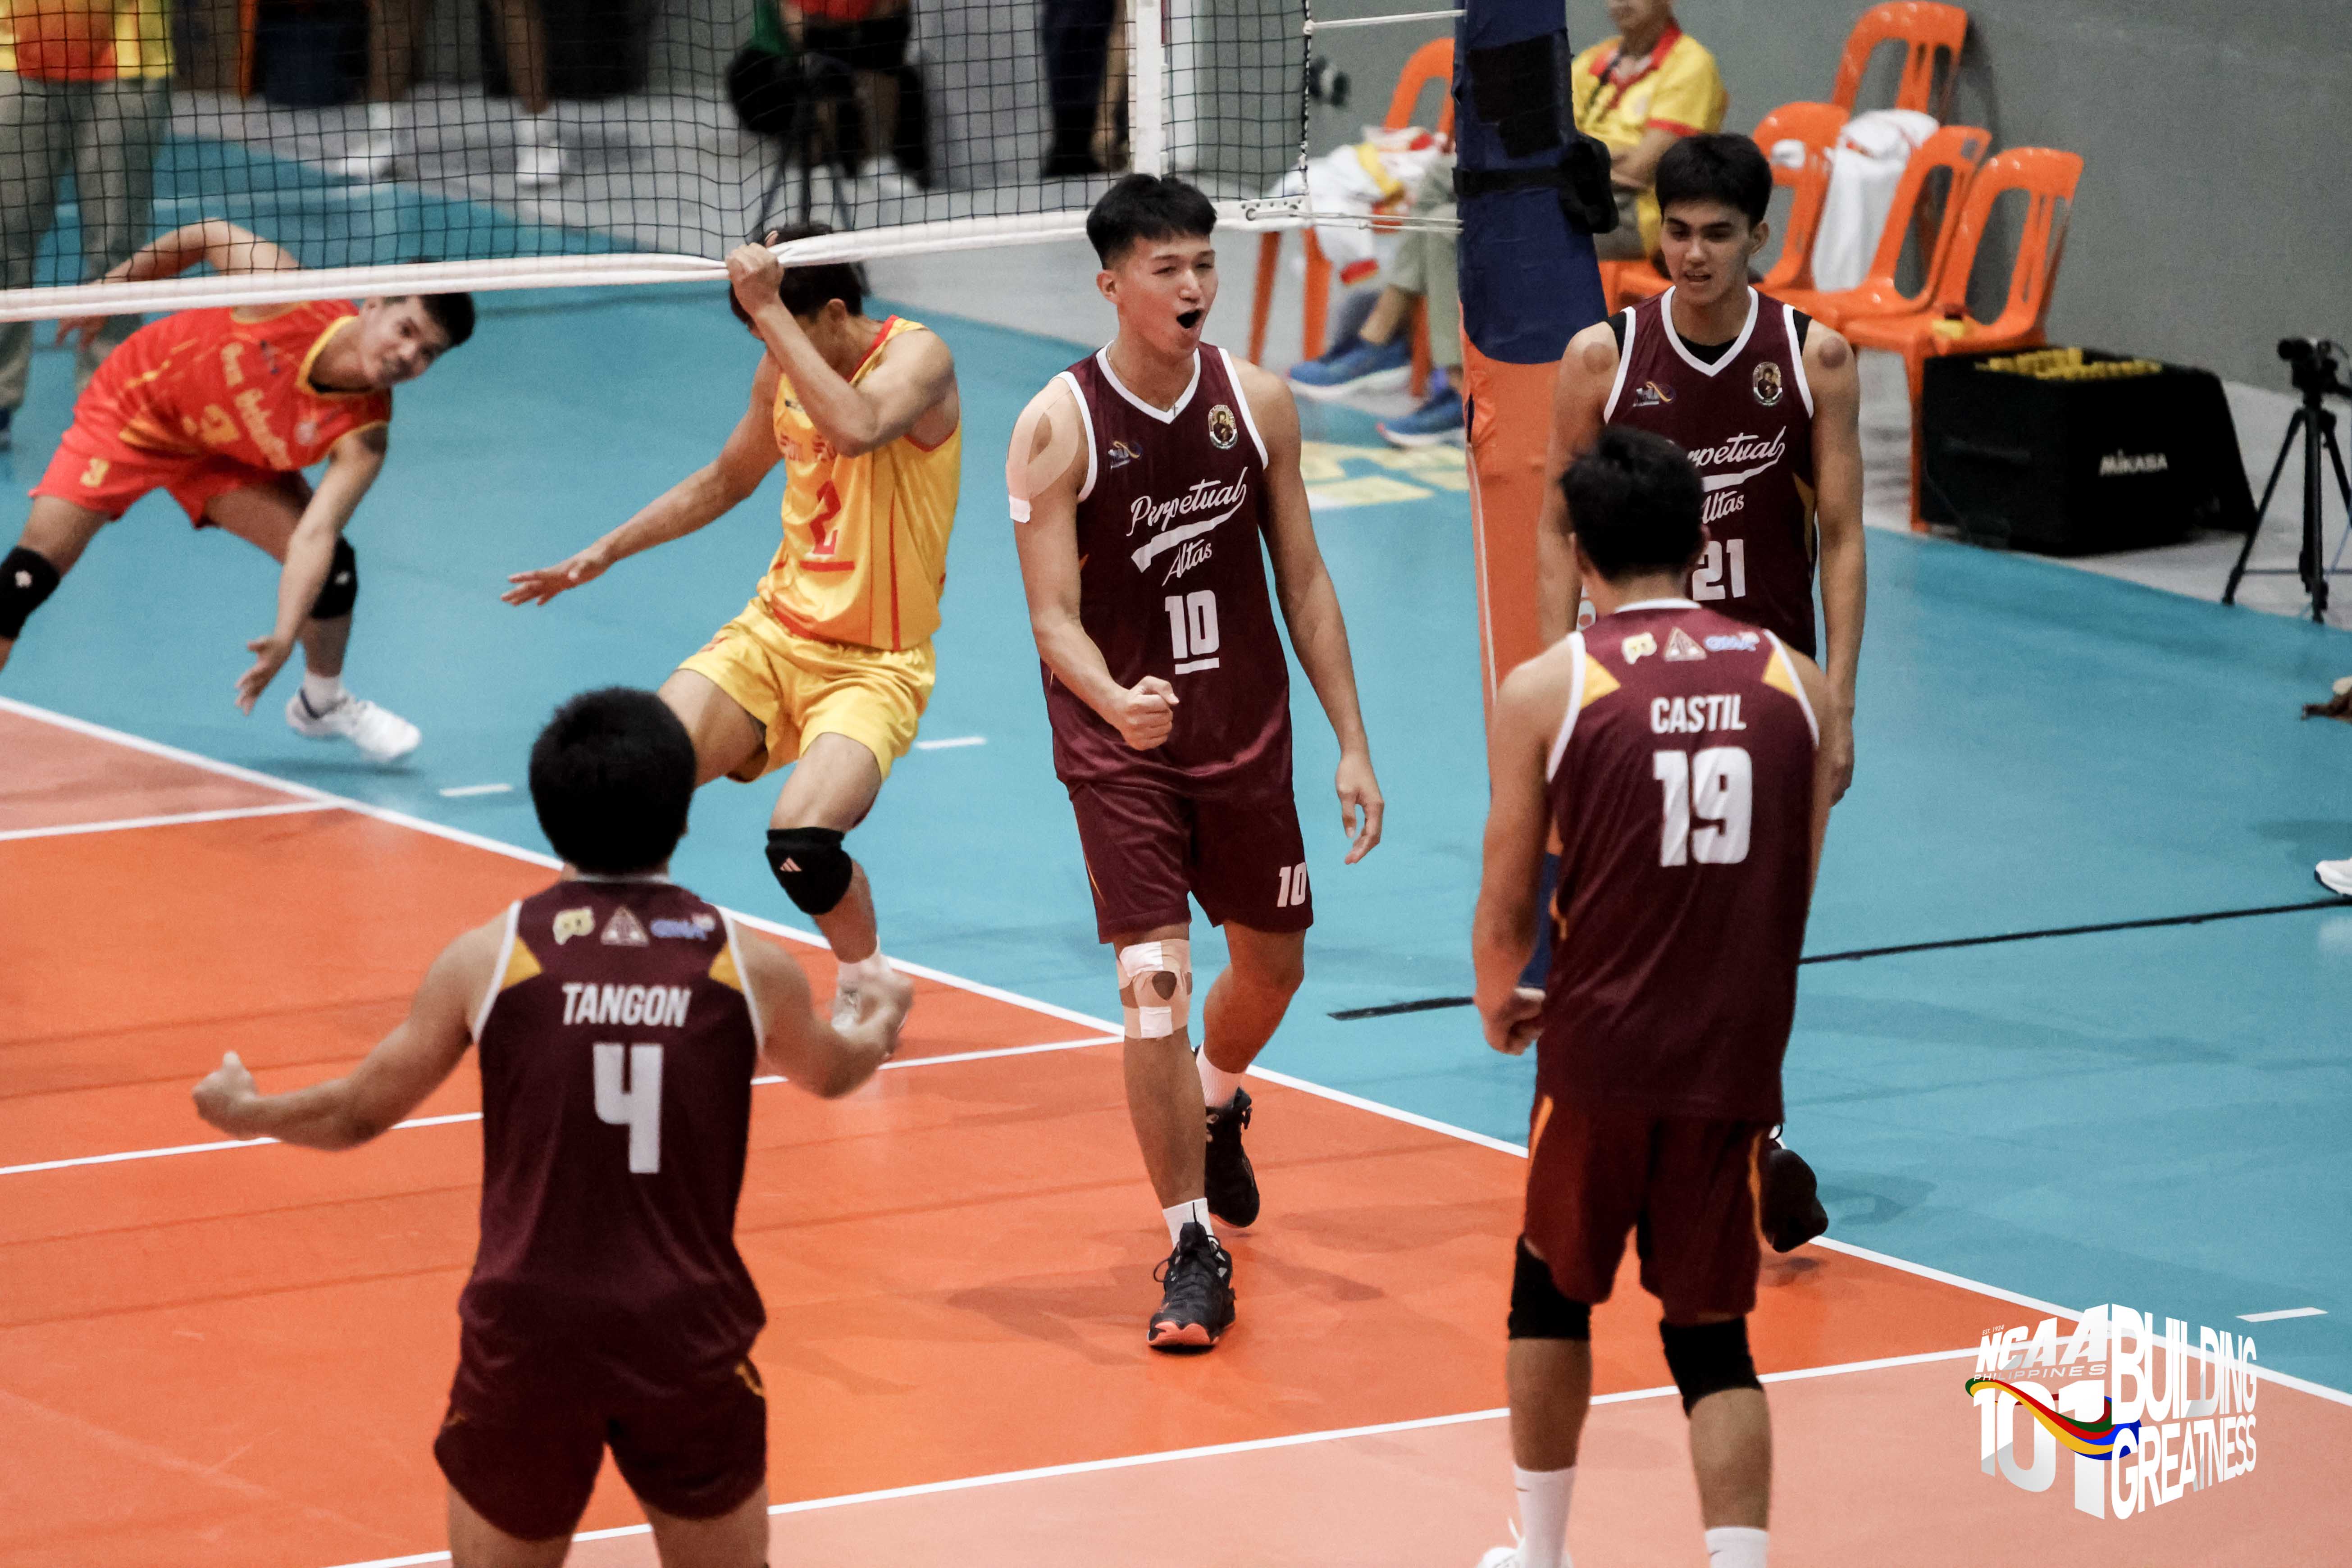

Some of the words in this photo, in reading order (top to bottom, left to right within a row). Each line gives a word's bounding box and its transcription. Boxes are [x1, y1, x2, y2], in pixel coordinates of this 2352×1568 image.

[1687, 425, 1787, 468] rpetual
[809, 480, 841, 554] 2
[1126, 466, 1248, 537] Perpetual
[1161, 539, 1212, 587] Altas
[1692, 538, 1746, 601] 21
[1165, 590, 1220, 659] 10
[1651, 694, 1747, 734] CASTIL
[1653, 746, 1753, 867] 19
[1277, 861, 1307, 907] 10
[562, 982, 692, 1027] TANGON
[593, 1042, 663, 1174] 4
